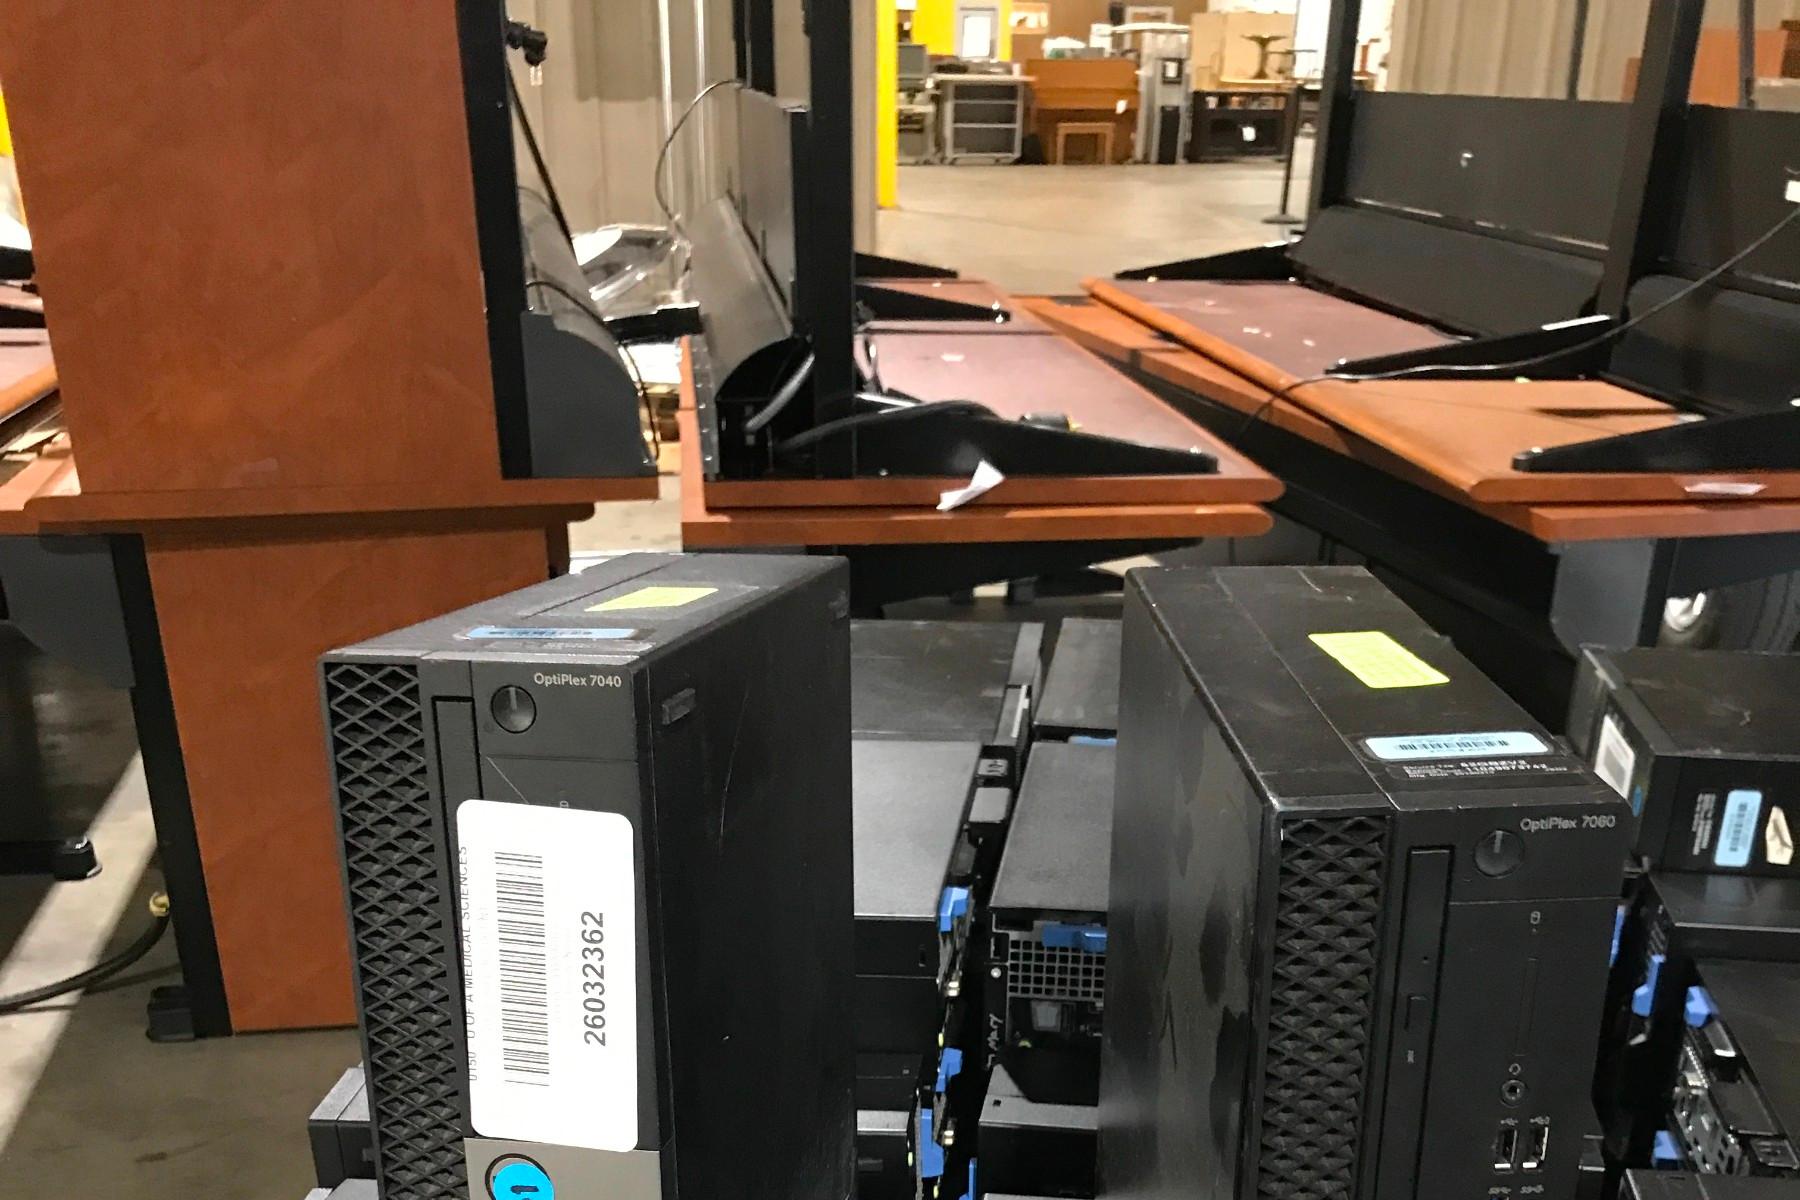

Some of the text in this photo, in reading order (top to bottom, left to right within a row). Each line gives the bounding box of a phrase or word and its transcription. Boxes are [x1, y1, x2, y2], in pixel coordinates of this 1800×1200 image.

[533, 672, 622, 688] OptiPlex 7040
[1520, 815, 1616, 833] OptiPlex 7060
[457, 845, 471, 921] SCIENCES
[461, 925, 474, 989] MEDICAL
[464, 993, 474, 1003] A
[580, 910, 607, 1048] 26032362
